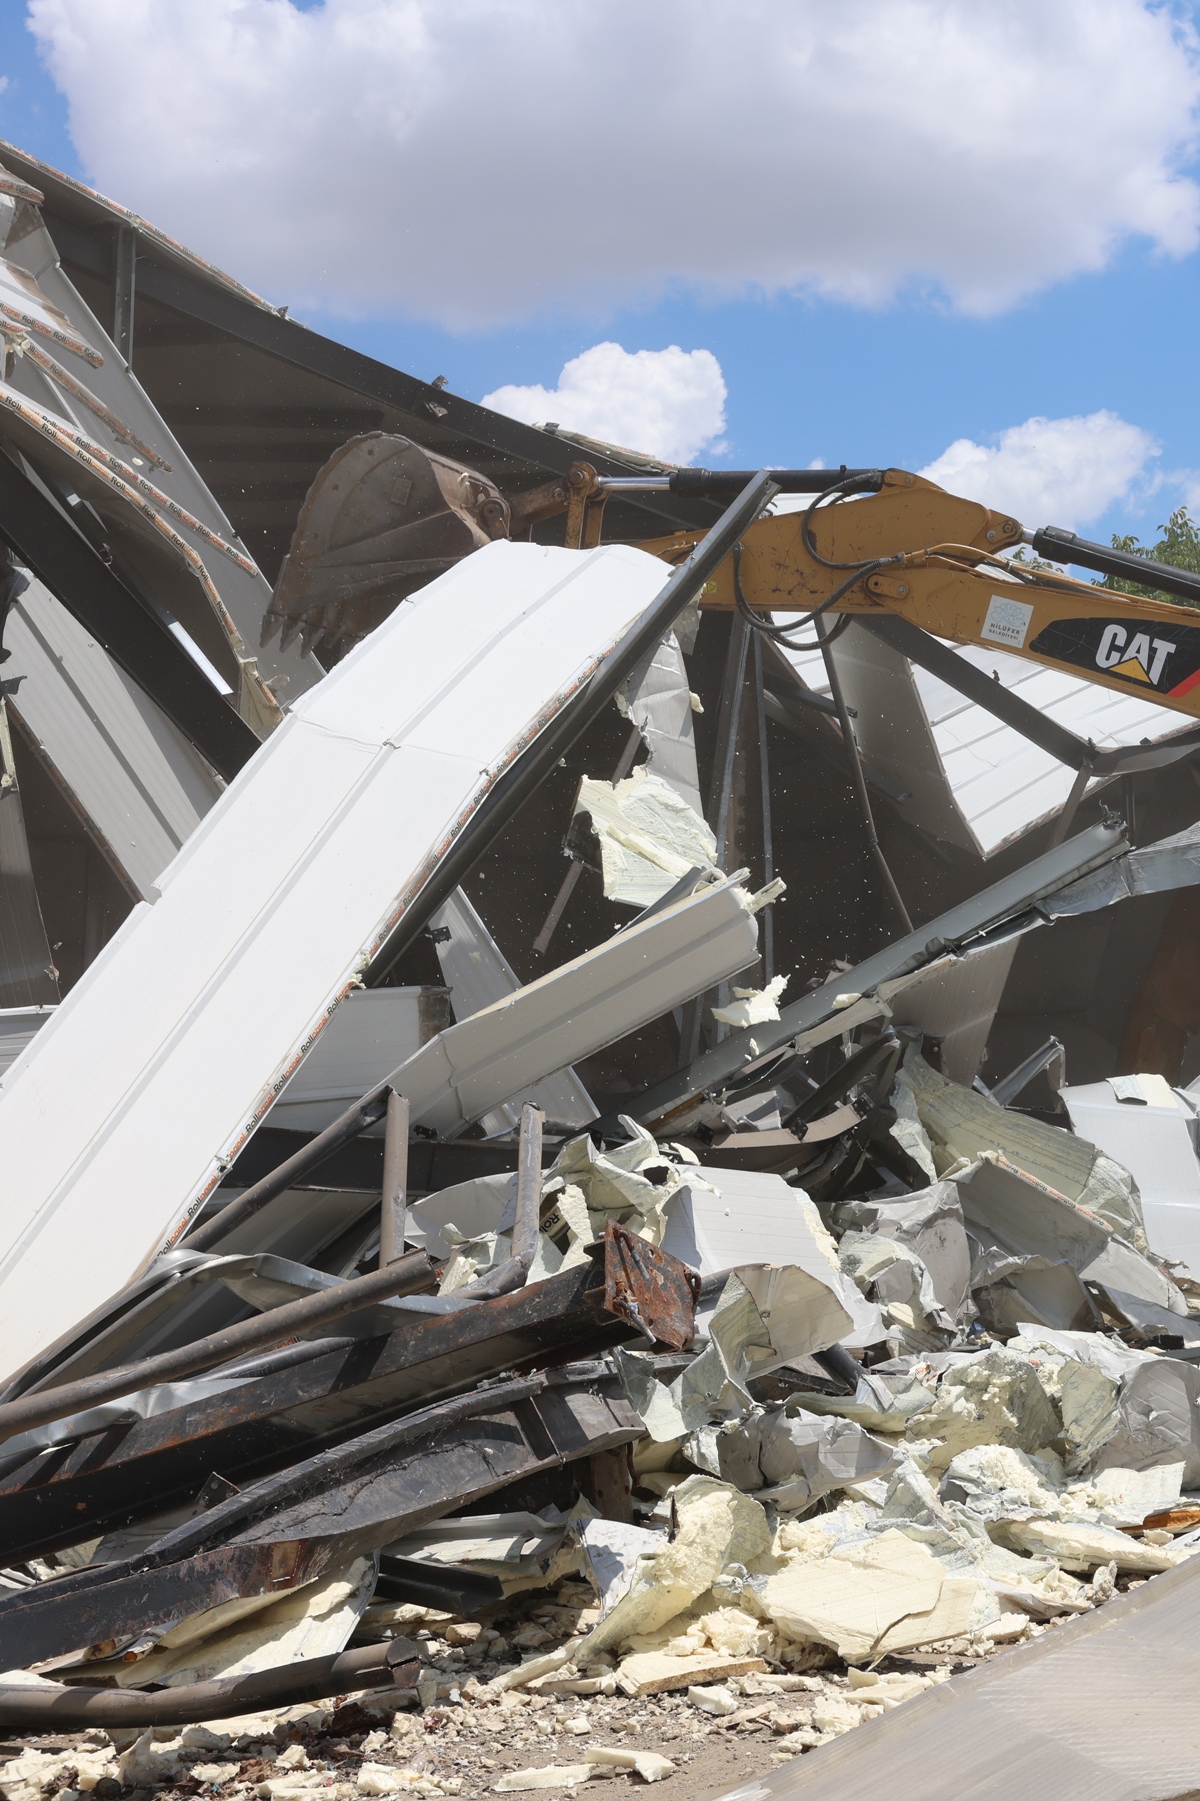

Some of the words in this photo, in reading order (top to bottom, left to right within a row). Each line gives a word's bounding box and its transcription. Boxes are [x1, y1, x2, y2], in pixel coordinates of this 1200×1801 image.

[22, 314, 52, 335] Rollpanel
[53, 331, 83, 351] Rollpanel
[5, 395, 40, 426] Rollpanel
[41, 422, 76, 452] Rollpanel
[76, 449, 110, 479] Rollpanel
[111, 475, 141, 506] Rollpanel
[142, 503, 172, 536] Rollpanel
[75, 436, 109, 460] Rollpanel
[109, 456, 139, 482] Rollpanel
[139, 478, 169, 504] Rollpanel
[168, 502, 197, 527] Rollpanel
[197, 525, 226, 549] Rollpanel
[225, 545, 254, 571] Rollpanel
[1095, 624, 1177, 686] CAT
[450, 804, 474, 838] Rollpanel
[187, 1175, 218, 1218] Rollpanel
[245, 1092, 276, 1133] Rollpanel
[273, 1053, 301, 1094] Rollpanel
[300, 1015, 328, 1054] Rollpanel
